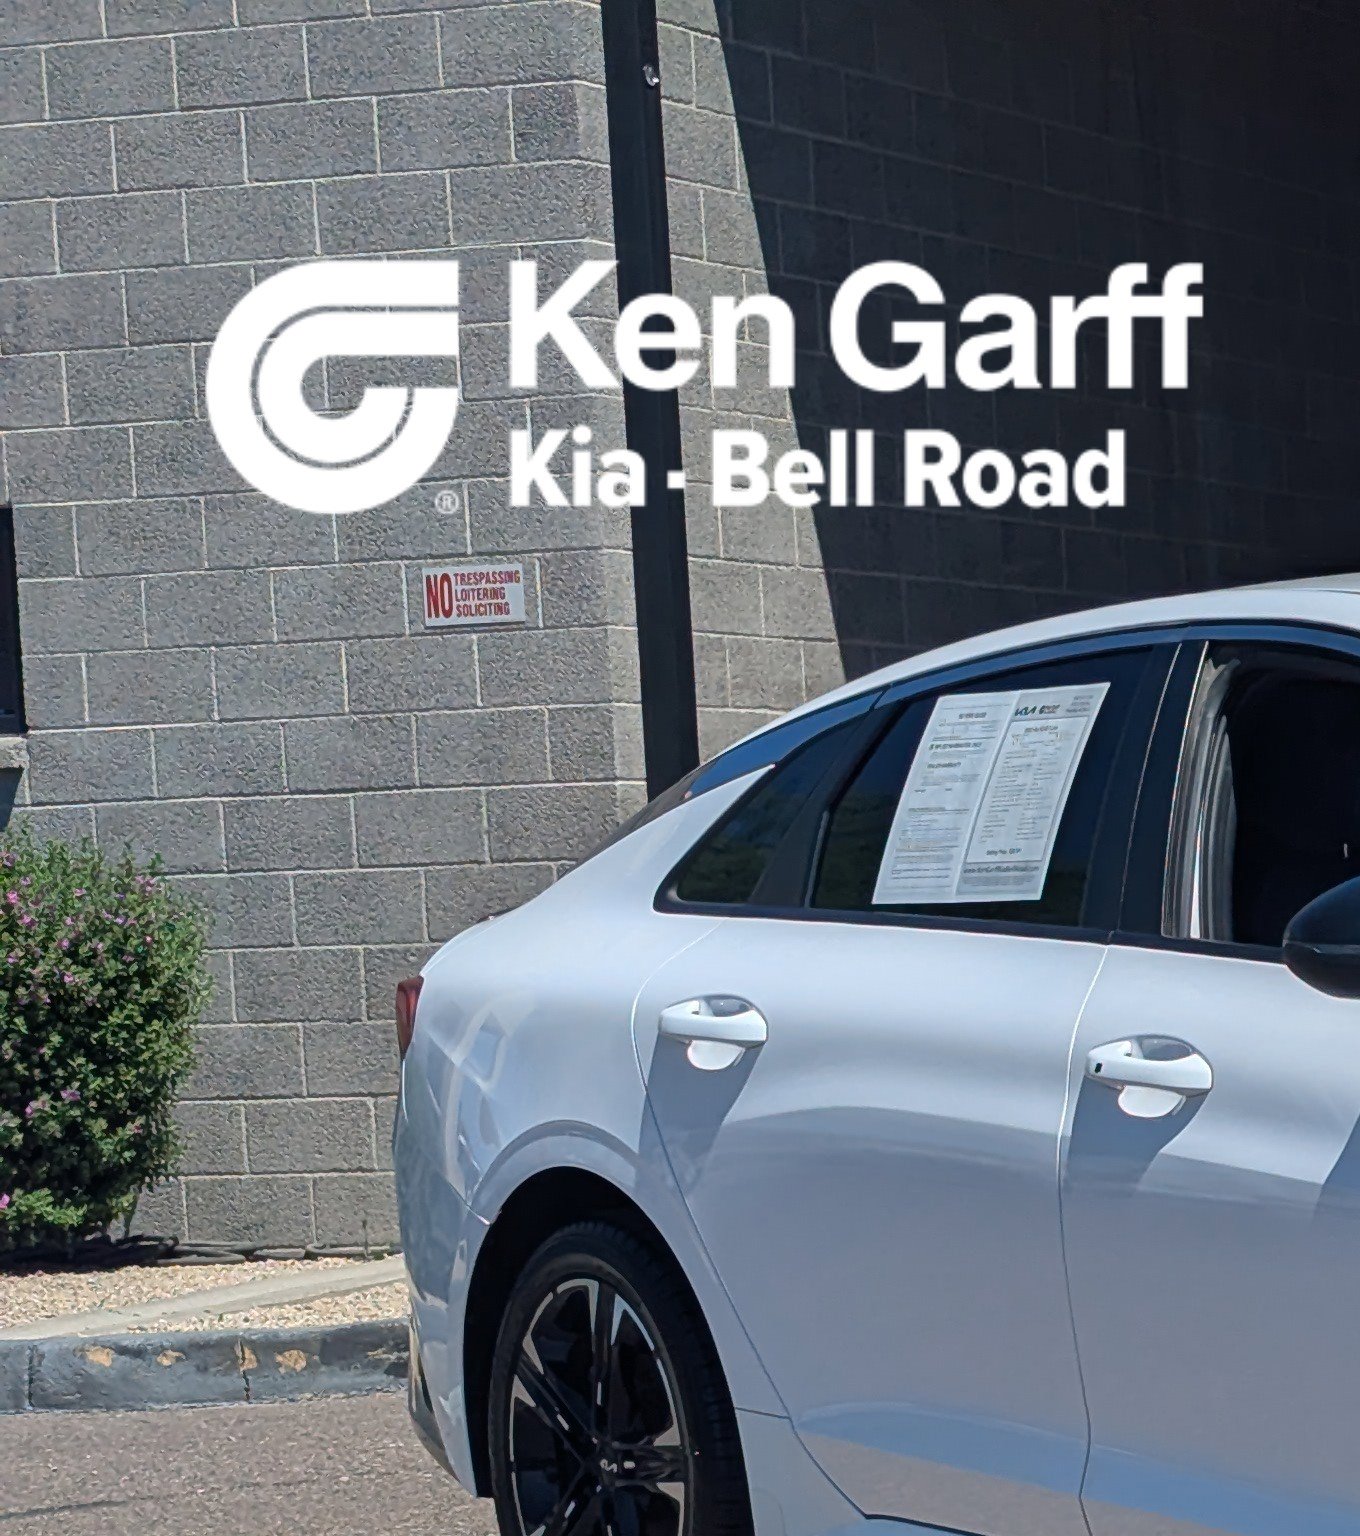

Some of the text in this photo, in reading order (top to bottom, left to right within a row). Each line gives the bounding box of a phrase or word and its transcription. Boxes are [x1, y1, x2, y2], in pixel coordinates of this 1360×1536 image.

[453, 570, 520, 585] TRESPASSING
[426, 573, 453, 618] NO
[455, 587, 505, 602] LOITERING
[456, 602, 511, 617] SOLICITING
